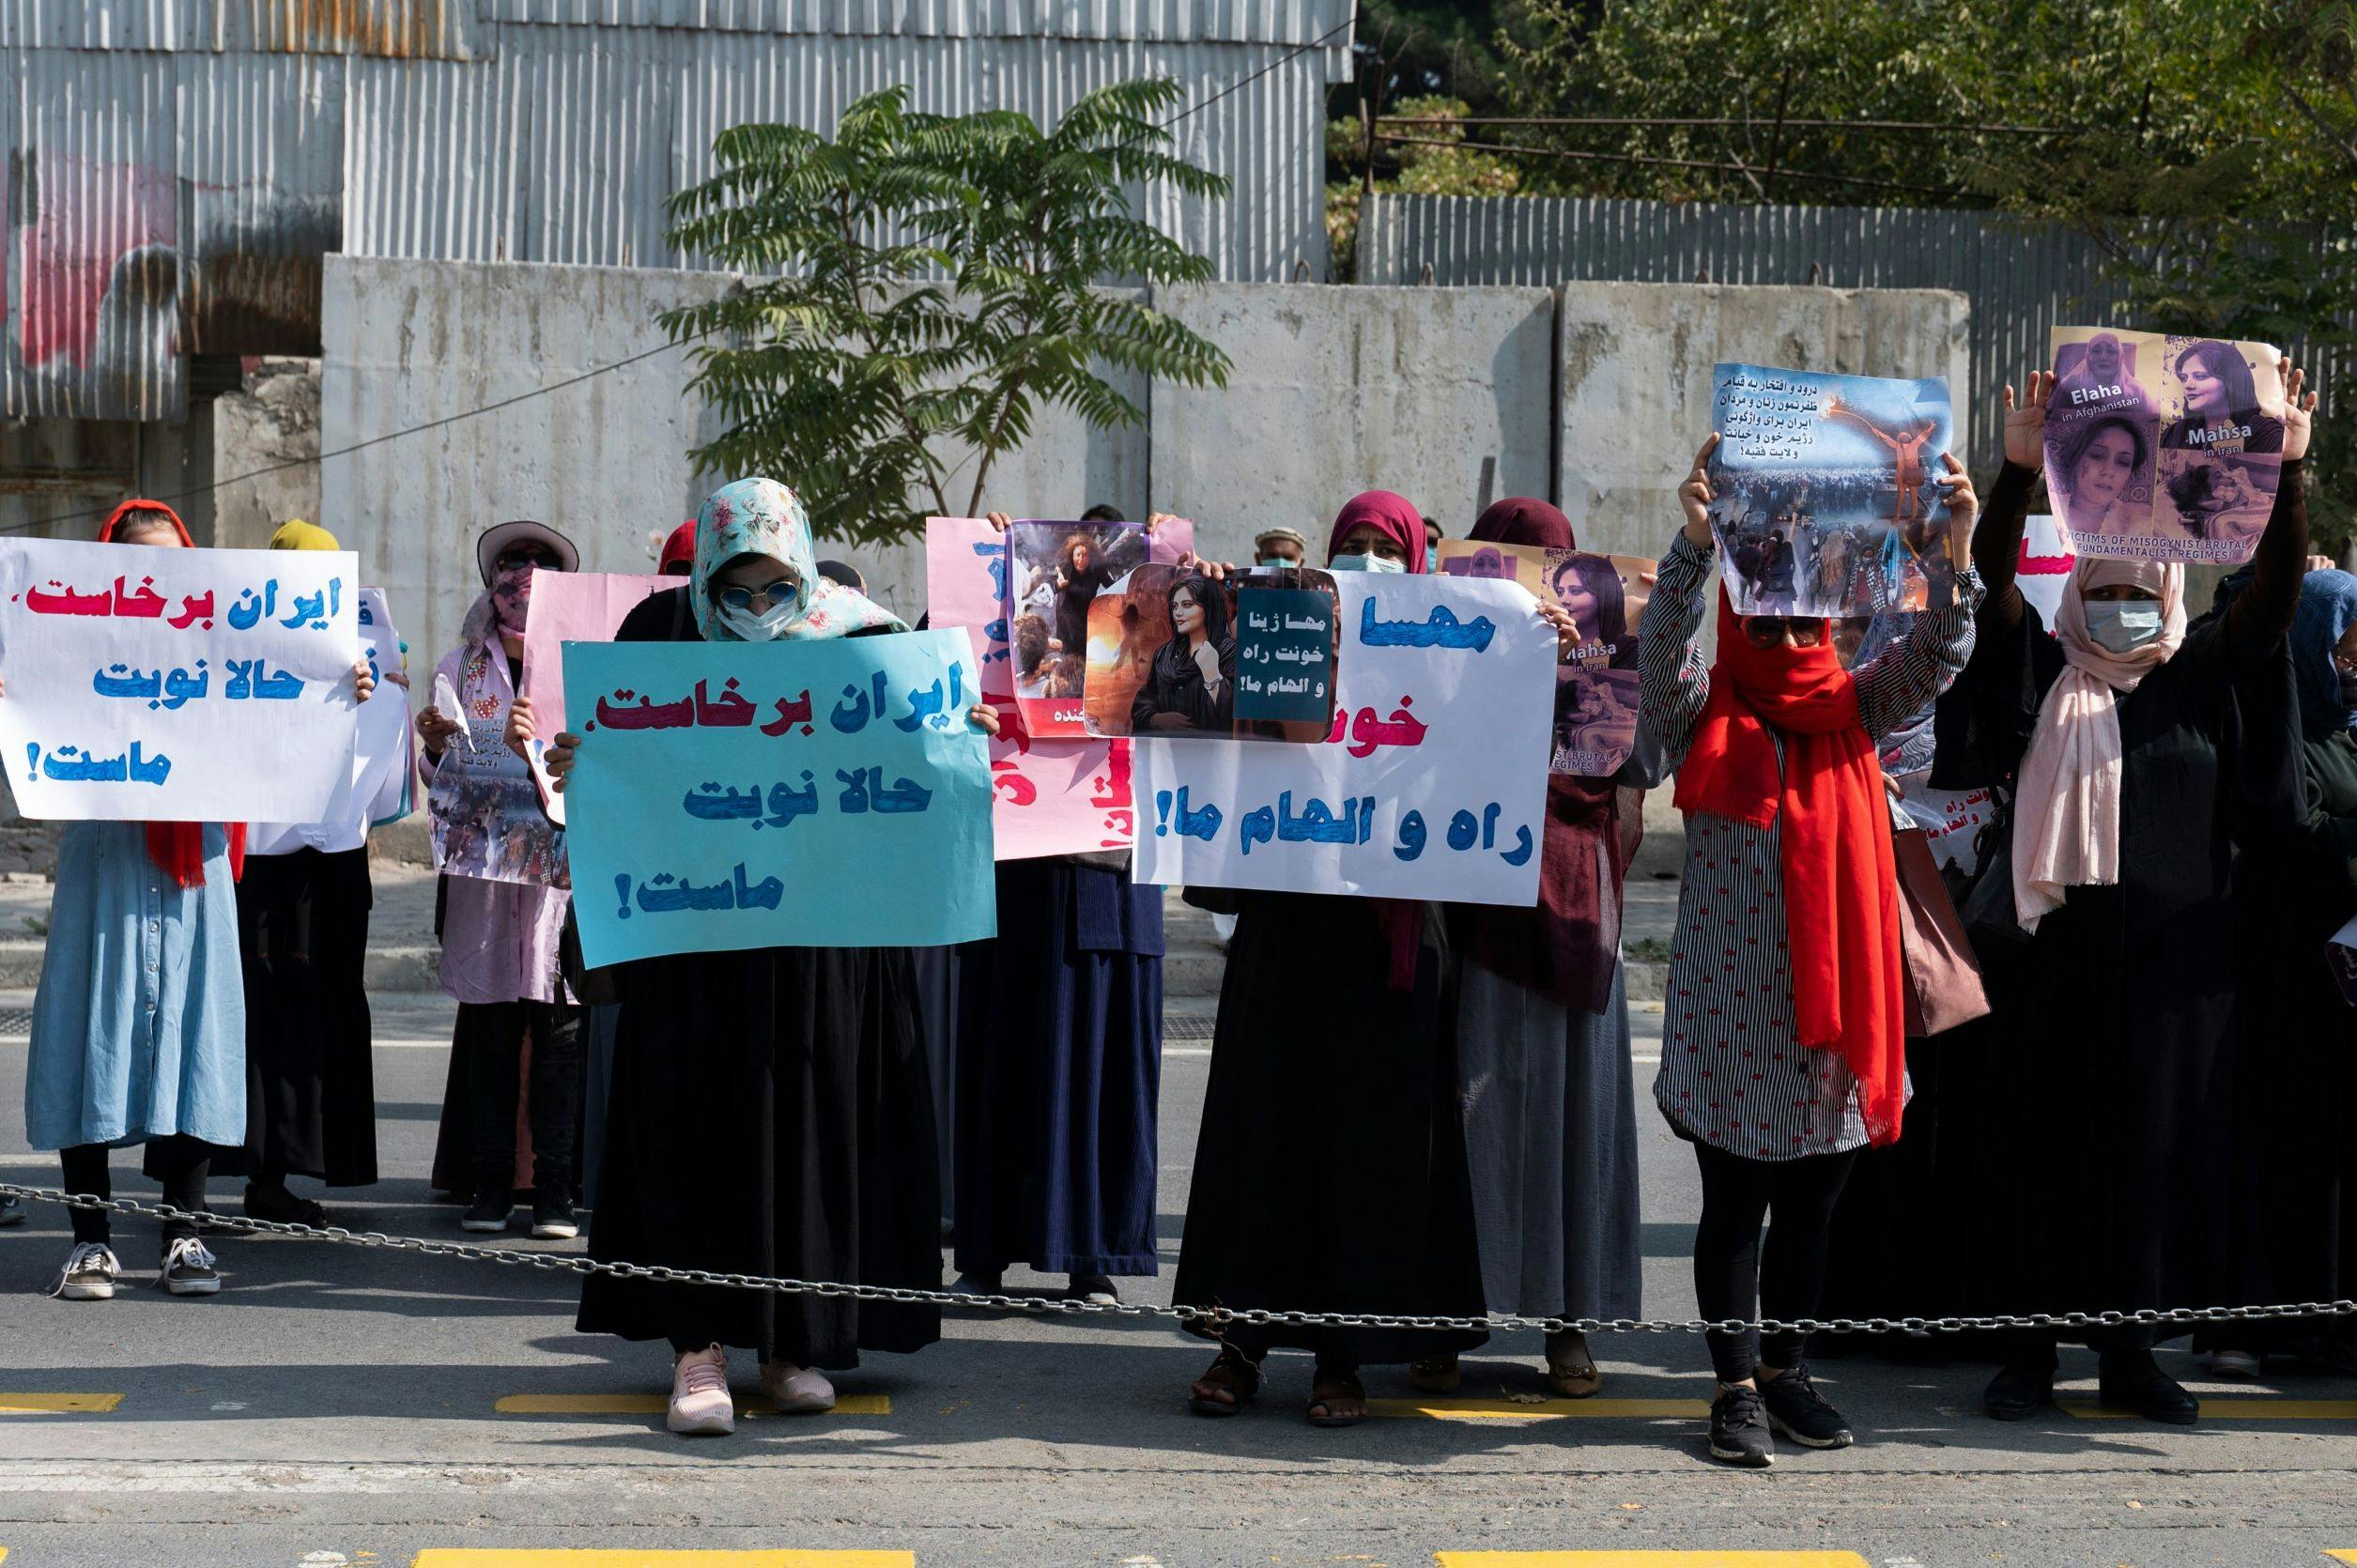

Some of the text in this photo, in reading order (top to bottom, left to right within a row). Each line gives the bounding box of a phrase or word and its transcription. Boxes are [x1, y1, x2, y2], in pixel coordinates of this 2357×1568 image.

[1722, 376, 1818, 396] درود و افتخار به قیام
[2071, 383, 2122, 405] Elaha
[1719, 393, 1747, 407] مردان
[1748, 399, 1754, 407] و
[1756, 397, 1776, 409] زنان
[2061, 397, 2140, 423] in Afghanistan
[1726, 410, 1811, 430] ایران برای واژگونی
[1724, 428, 1813, 444] رژیم خون و خیانت
[2188, 423, 2252, 445] Mahsa
[1740, 446, 1798, 459] ولایت فقیه!
[2203, 445, 2240, 457] in Iran
[2066, 531, 2246, 550] VICTIMS OF MISOGYNIST BRUTAL
[2077, 543, 2232, 560] FUNDAMENTALIST REGIMES!
[227, 577, 341, 630] ایران
[1249, 611, 1326, 633] مهسا ژینا
[1360, 595, 1496, 653] مهسا
[1242, 643, 1324, 666] خونت راه
[1574, 663, 1607, 673] in Iran
[93, 658, 304, 711] حالا نوبت
[1240, 675, 1324, 698] و الهام ما!
[830, 661, 963, 733] ایران
[27, 740, 171, 787] ماست!
[1572, 751, 1610, 761] BRUTAL
[683, 764, 932, 830] حالا نوبت
[1946, 800, 1965, 813] راه
[1156, 785, 1533, 866] راه و الهام ما!
[1942, 814, 1968, 838] الهام
[1971, 813, 1980, 825] و
[614, 862, 784, 919] ماست!
